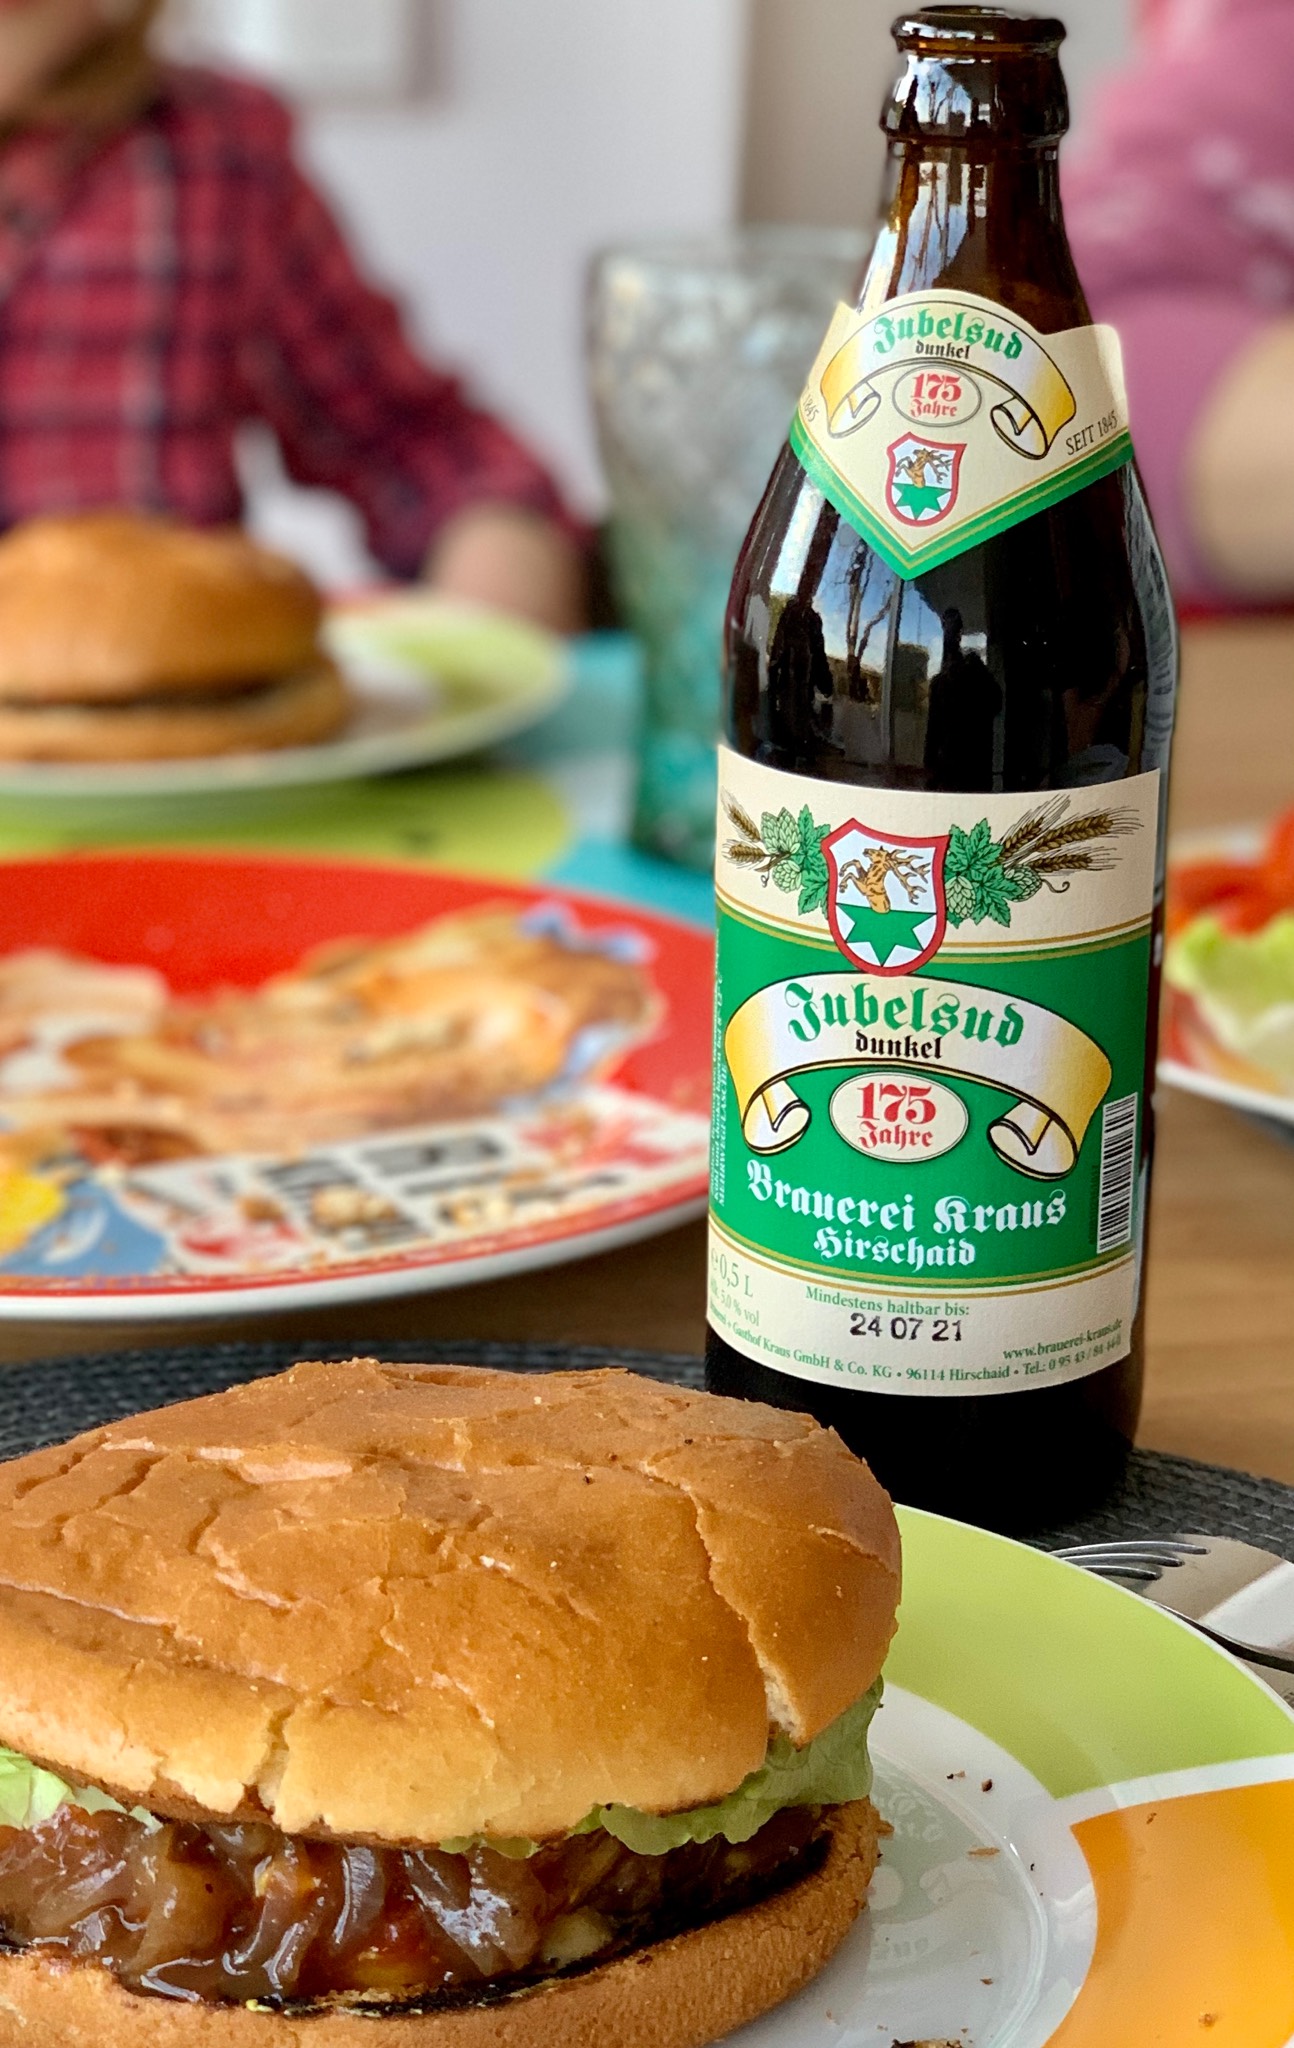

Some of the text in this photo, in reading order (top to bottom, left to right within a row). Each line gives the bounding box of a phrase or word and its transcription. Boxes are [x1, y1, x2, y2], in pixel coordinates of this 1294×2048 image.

[873, 309, 1024, 361] Jubelsud
[915, 340, 971, 360] dunkel
[911, 373, 963, 403] 175
[910, 399, 958, 421] Jahre
[1065, 410, 1119, 457] SEIT 1845
[784, 981, 1026, 1049] Jubelsud
[854, 1029, 945, 1060] dunkel
[857, 1081, 938, 1125] 175
[857, 1120, 935, 1151] Jahre
[746, 1158, 916, 1232] Brauerei
[932, 1188, 1068, 1235] Kraus
[813, 1228, 977, 1272] Hirschaid
[720, 1253, 740, 1288] 0,5
[744, 1274, 754, 1298] L
[744, 1308, 760, 1327] vol
[805, 1286, 970, 1316] Mindestens haltbar bis:
[850, 1312, 963, 1342] 24 07 21
[763, 1336, 791, 1358] Kraus
[793, 1349, 830, 1369] GmbH
[834, 1359, 844, 1372] &
[847, 1361, 868, 1376] Co.
[872, 1364, 892, 1378] KG
[905, 1368, 945, 1381] 96114
[949, 1365, 1010, 1381] Hirschaid
